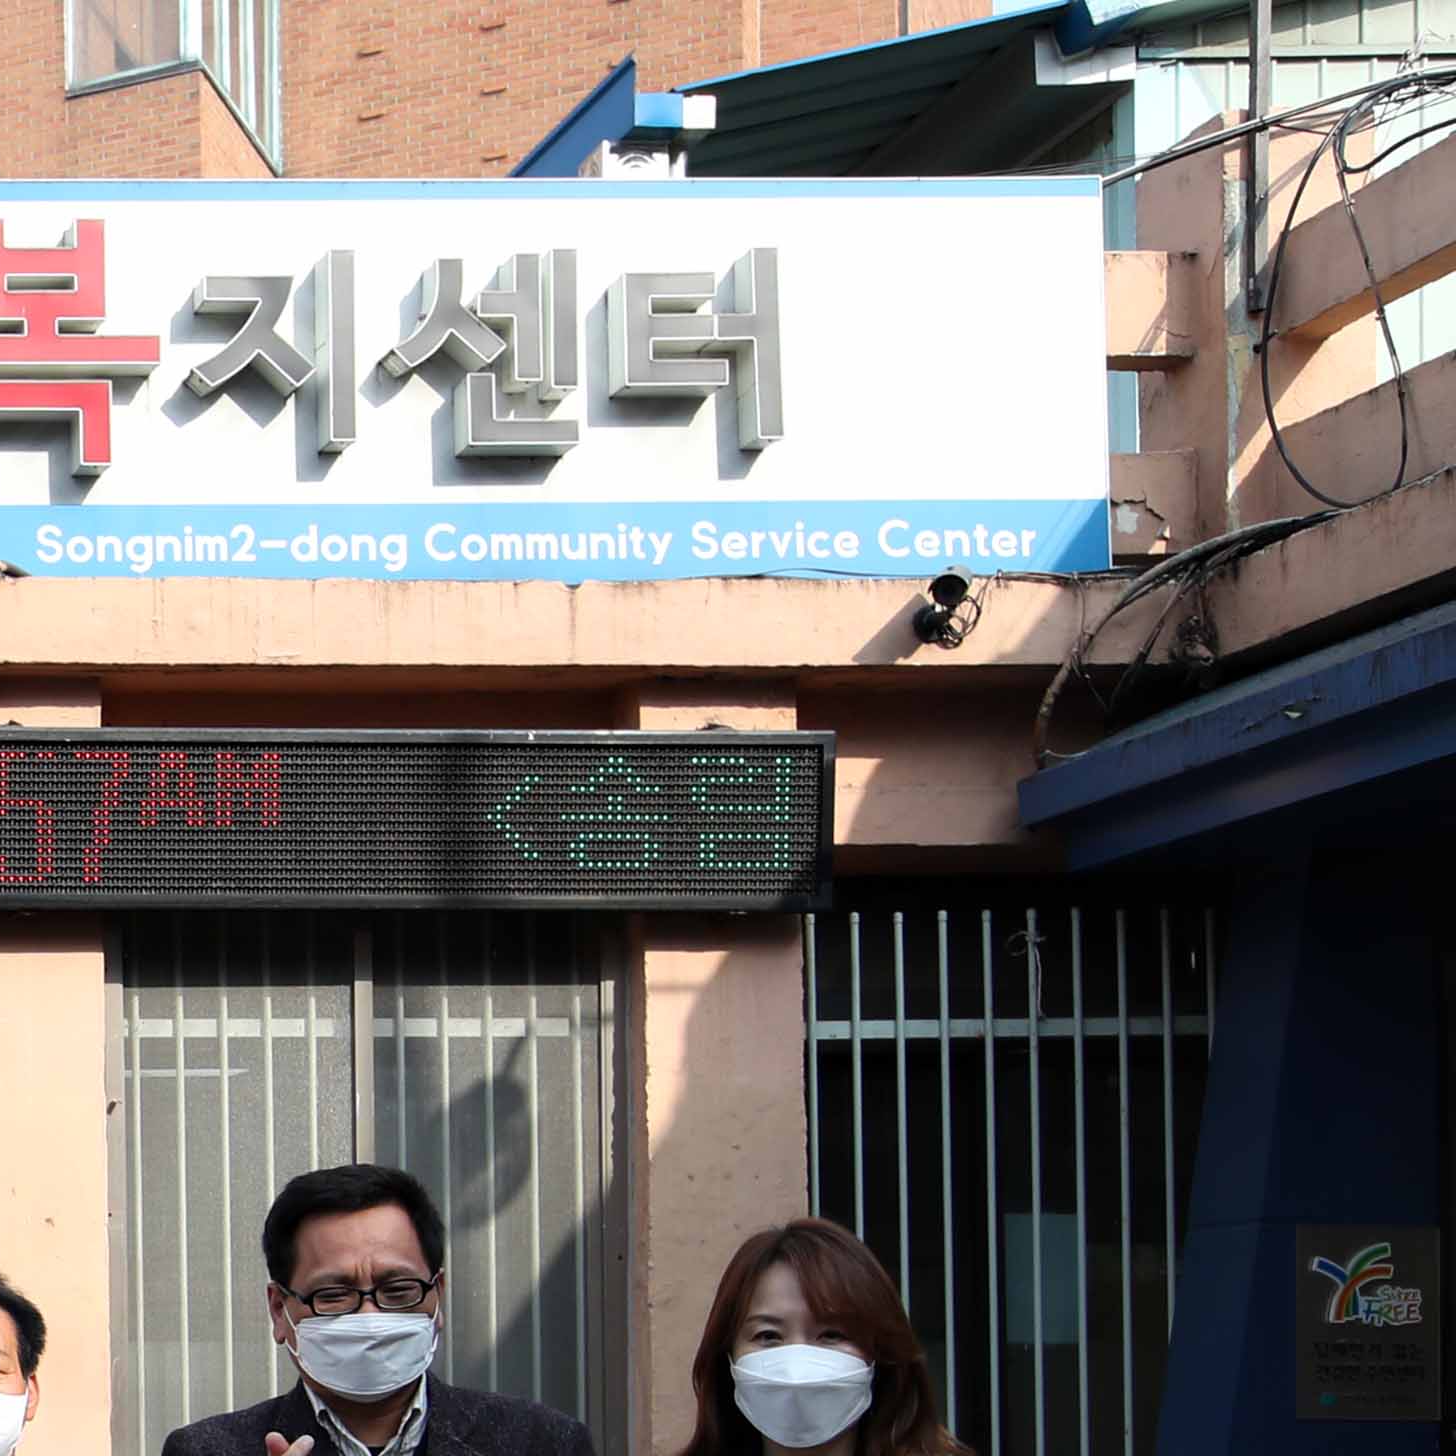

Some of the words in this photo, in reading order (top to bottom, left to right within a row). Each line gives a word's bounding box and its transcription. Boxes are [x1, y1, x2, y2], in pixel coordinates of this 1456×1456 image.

[34, 523, 408, 574] Songnim2-dong
[424, 522, 673, 566] Community
[690, 520, 860, 560] Service
[877, 518, 1037, 558] Center
